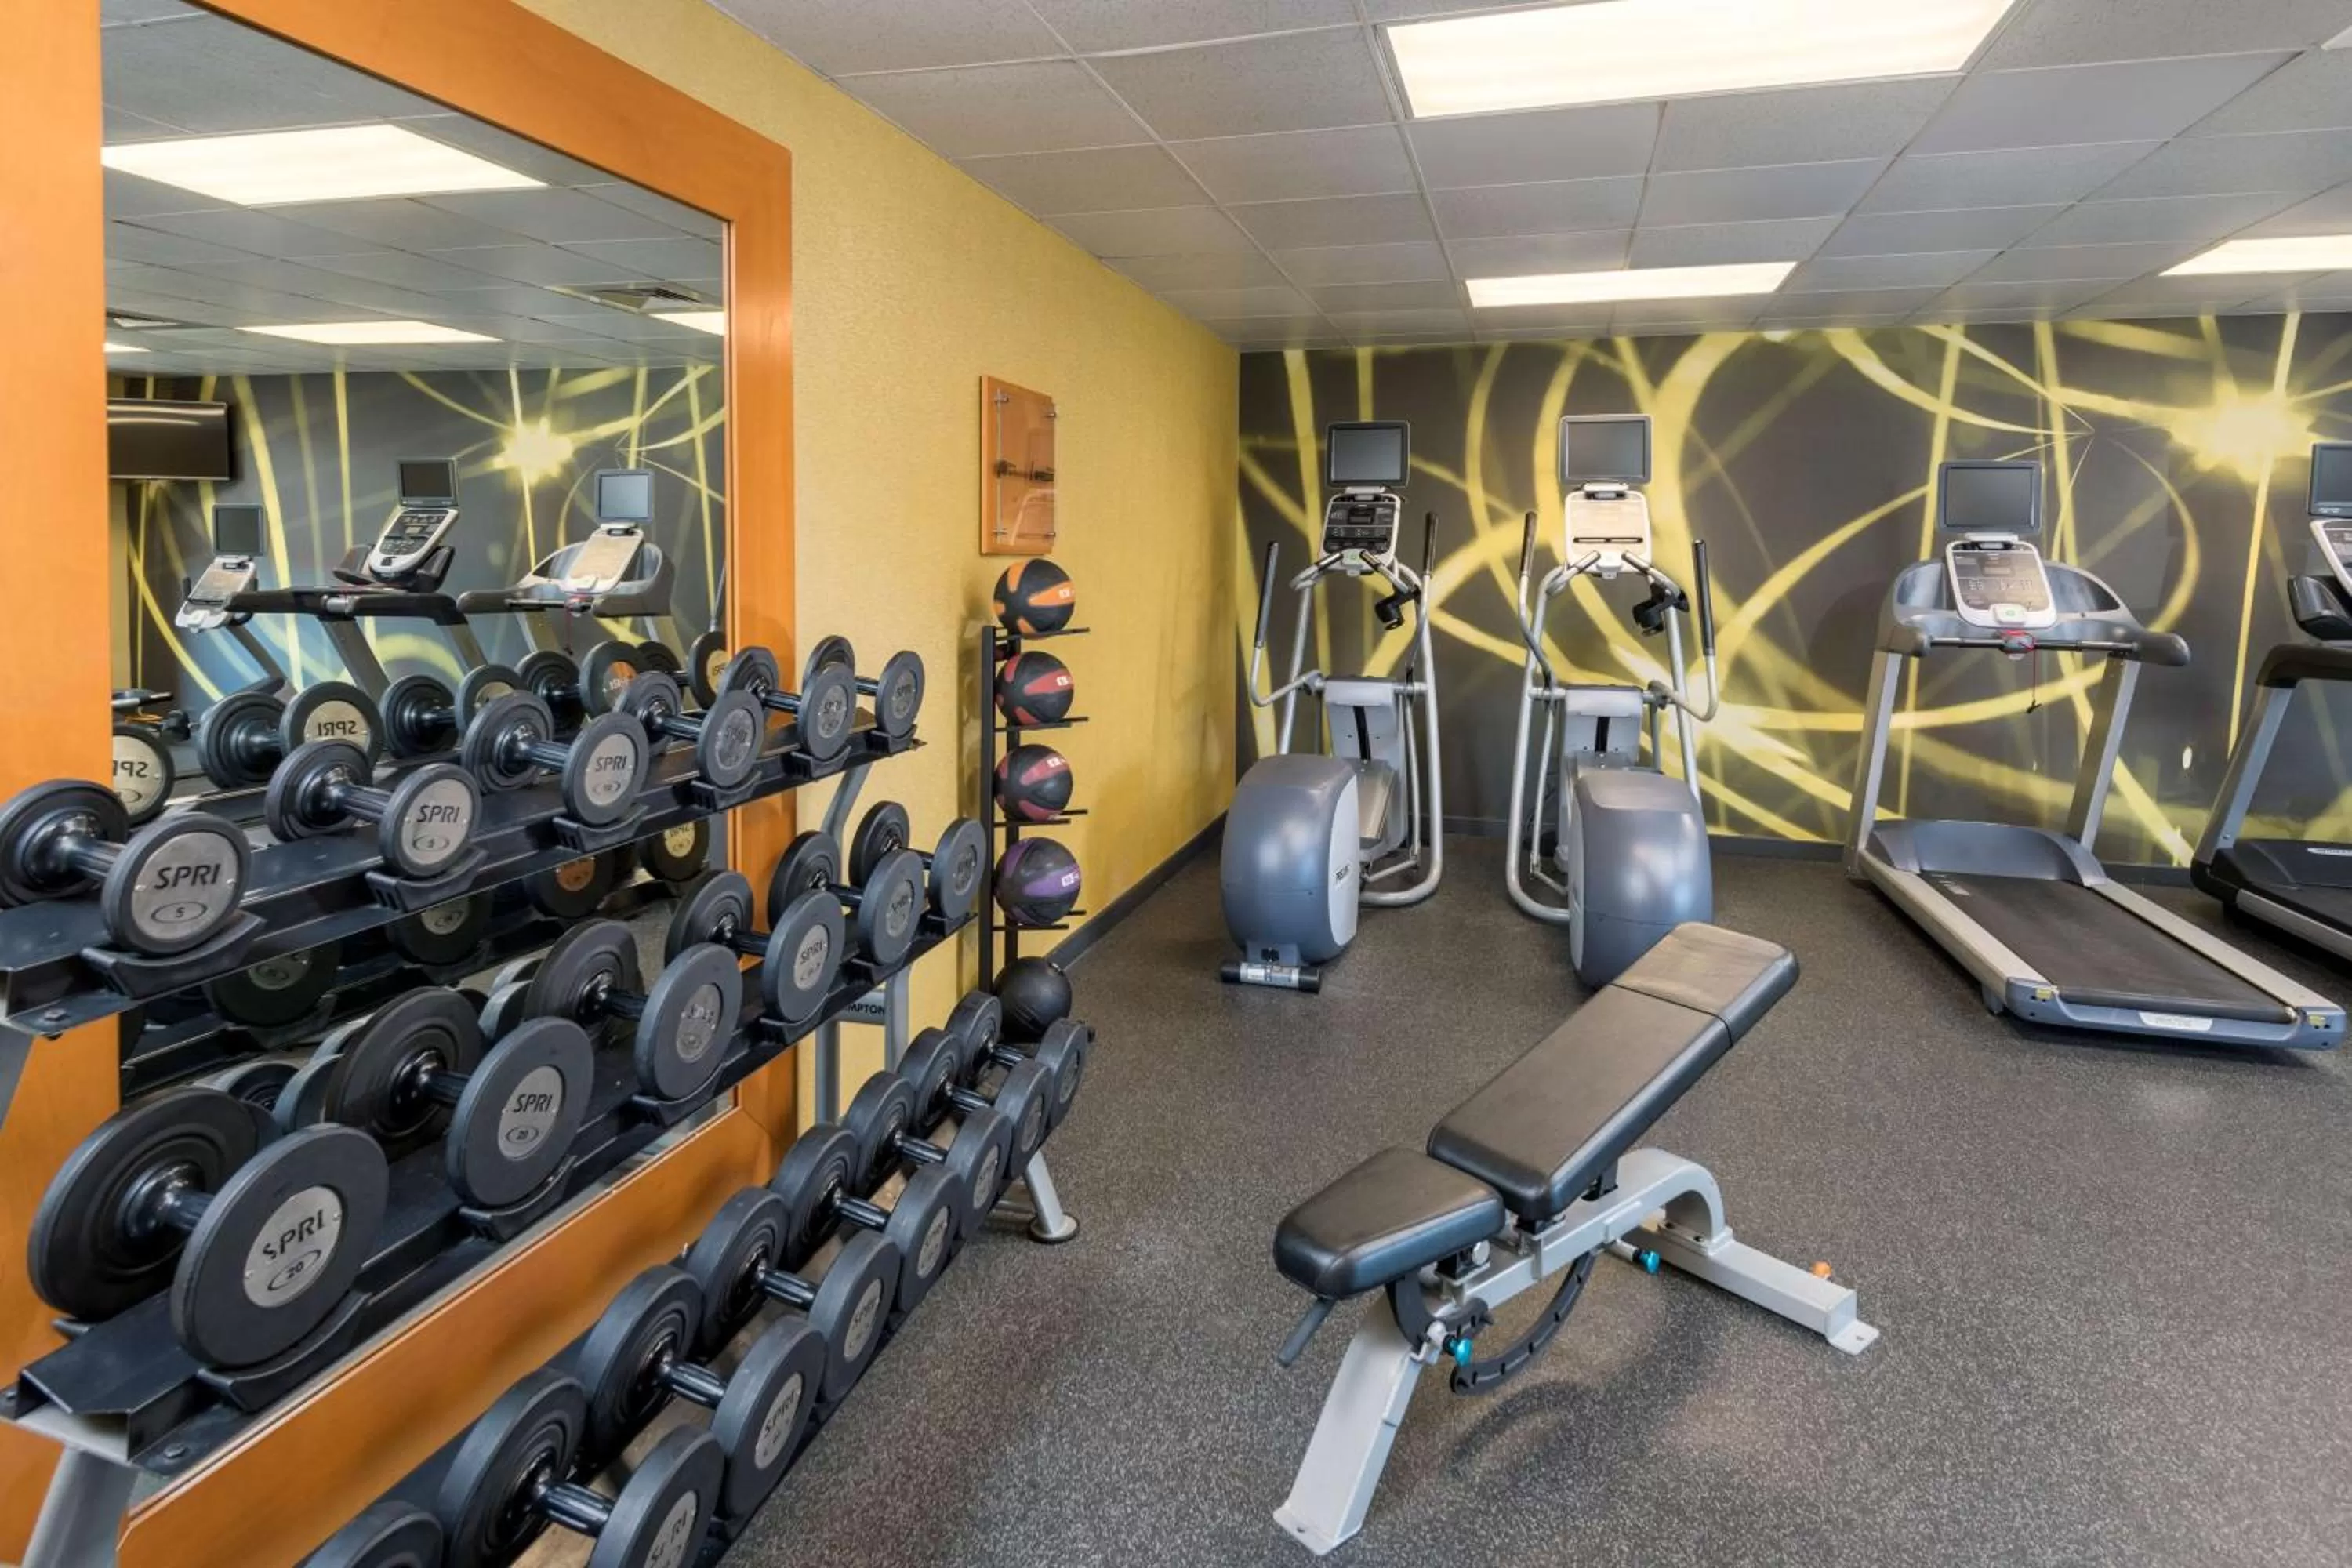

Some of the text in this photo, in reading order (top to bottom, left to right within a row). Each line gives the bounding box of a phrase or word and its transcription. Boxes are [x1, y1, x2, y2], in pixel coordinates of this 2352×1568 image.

[595, 756, 627, 772] SPRI
[416, 805, 460, 823] SPRI
[154, 863, 221, 890] SPRI
[514, 1094, 553, 1113] SPRI
[263, 1209, 324, 1259] SPRI
